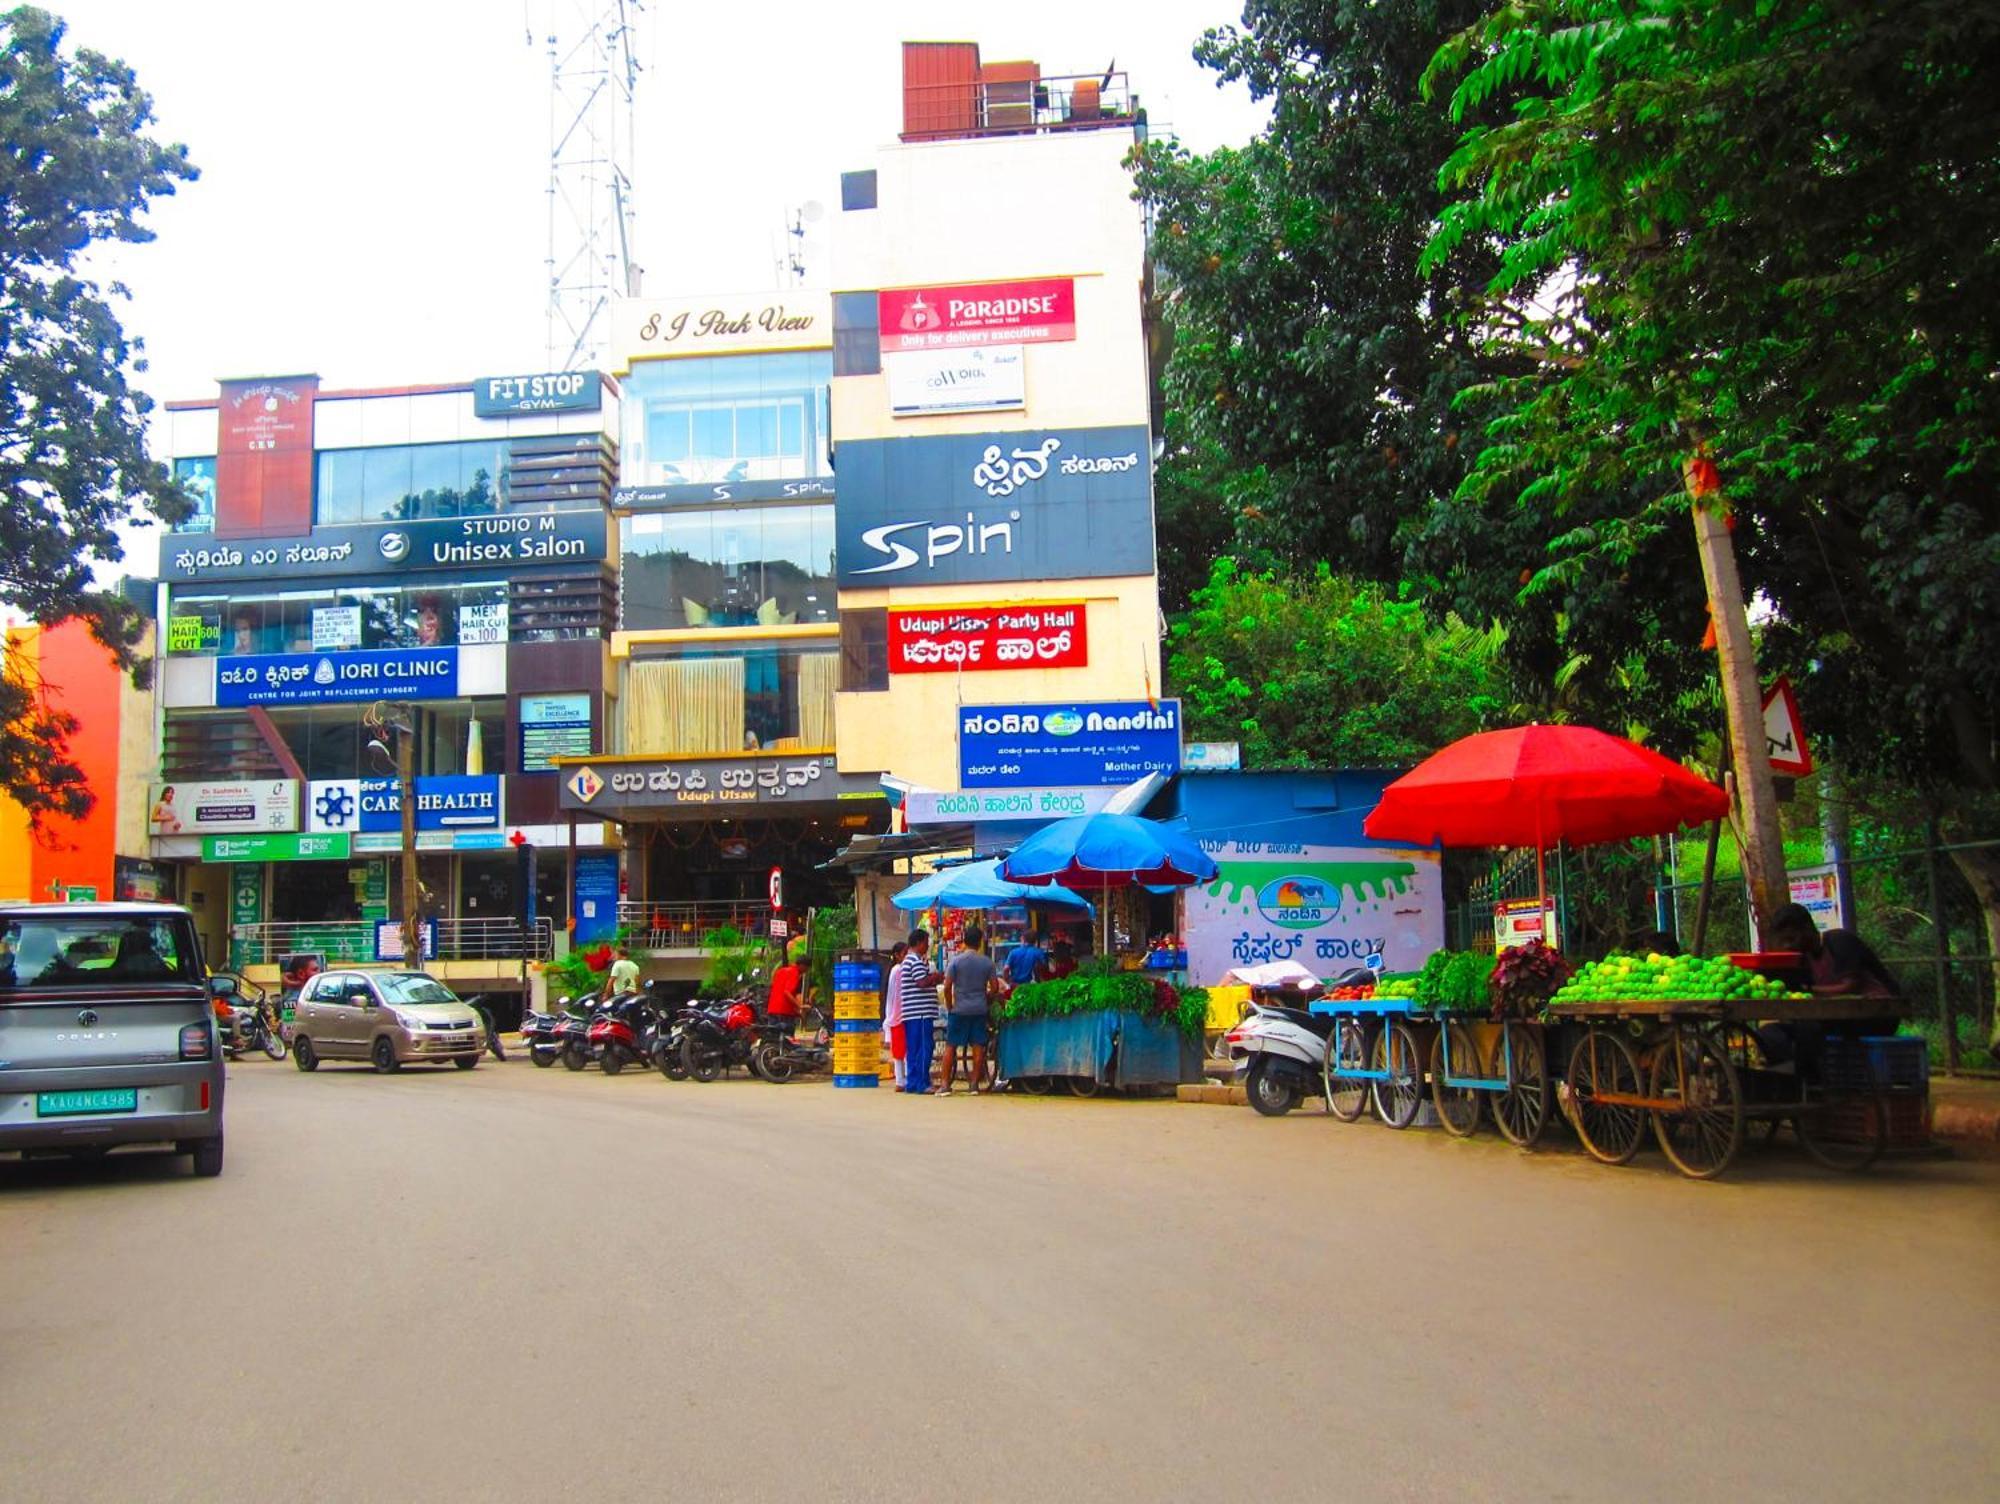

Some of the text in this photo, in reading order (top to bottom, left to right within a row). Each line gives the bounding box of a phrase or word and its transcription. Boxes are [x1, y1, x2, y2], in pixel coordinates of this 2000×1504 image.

[640, 313, 661, 341] S
[693, 309, 751, 337] Park
[759, 306, 814, 332] View
[901, 327, 1049, 347] Only for delivery executives
[489, 374, 584, 400] FIT STOP
[520, 399, 555, 409] GYM
[1060, 452, 1138, 475] ಸಲೂನ್
[463, 517, 556, 536] STUDIO M
[433, 535, 585, 562] Unisex Salon
[848, 511, 1012, 574] Spin
[251, 550, 277, 564] ಎಂ
[286, 542, 351, 563] ಸಲೂನ್
[471, 606, 498, 617] MEN
[171, 617, 200, 626] WOMEN
[462, 620, 485, 628] HAIR
[900, 617, 945, 635] Udupi
[998, 613, 1040, 632] Party
[1043, 611, 1075, 627] Hall
[172, 626, 199, 638] HAIR
[478, 627, 498, 641] 100
[174, 639, 197, 649] CUT
[996, 630, 1071, 661] ಹಾಲ್
[340, 660, 449, 679] IORI CLINIC
[248, 692, 277, 700] CENTRE
[299, 689, 321, 697] JOINT
[325, 687, 379, 696] REPLACEMENT
[383, 686, 417, 695] SURGERY
[964, 713, 1040, 734] ನಂದಿನಿ
[1087, 710, 1175, 732] Nandini
[1105, 760, 1173, 772] Mother Dairy
[611, 760, 821, 796] ಉಡುಪಿ ಉತ್ಸವ್
[361, 792, 493, 811] CAR HEALTH
[677, 789, 757, 803] Udupi Utsav
[985, 793, 1033, 811] ಹಾಲಿನ
[1040, 792, 1085, 814] ಕೇಂದ್ರ
